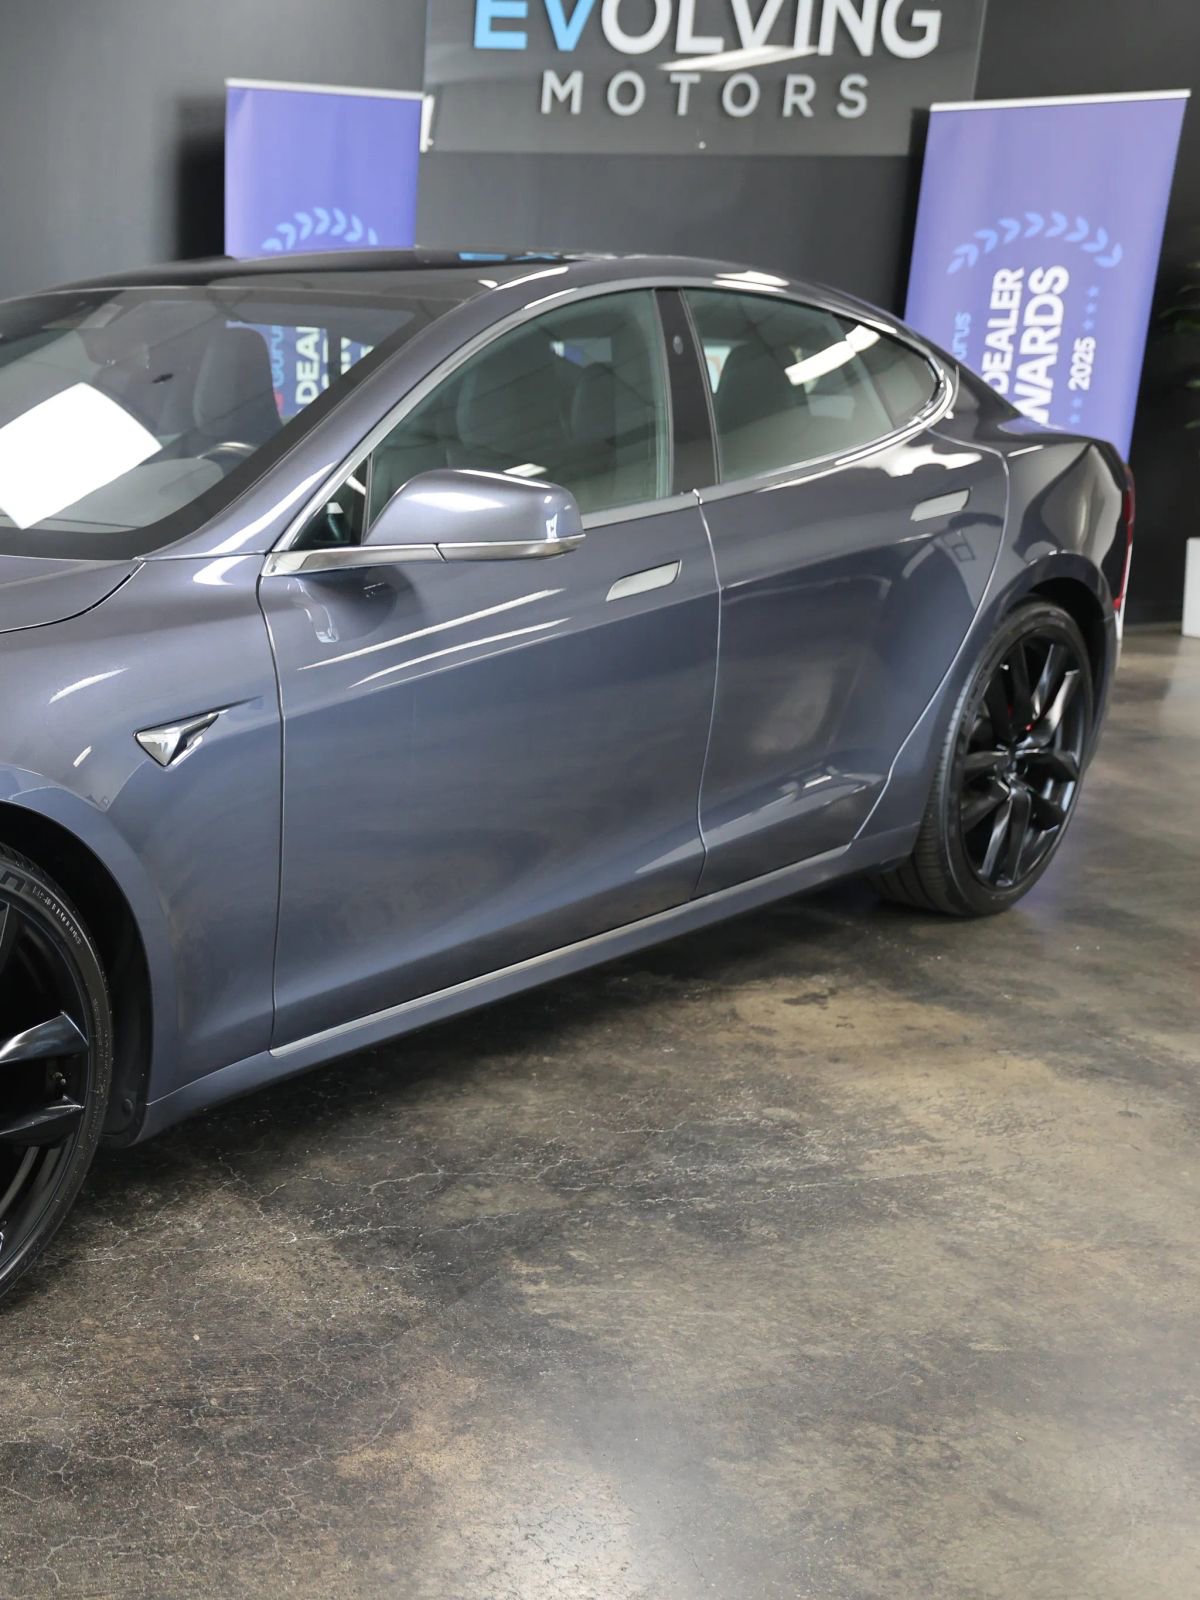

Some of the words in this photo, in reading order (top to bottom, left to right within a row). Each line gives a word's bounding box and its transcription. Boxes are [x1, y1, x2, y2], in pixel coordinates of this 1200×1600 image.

[474, 0, 942, 58] EVOLVING
[541, 71, 870, 119] MOTORS
[981, 267, 1025, 394] DEALER
[1013, 265, 1070, 424] WARDS
[1068, 336, 1097, 391] 2025
